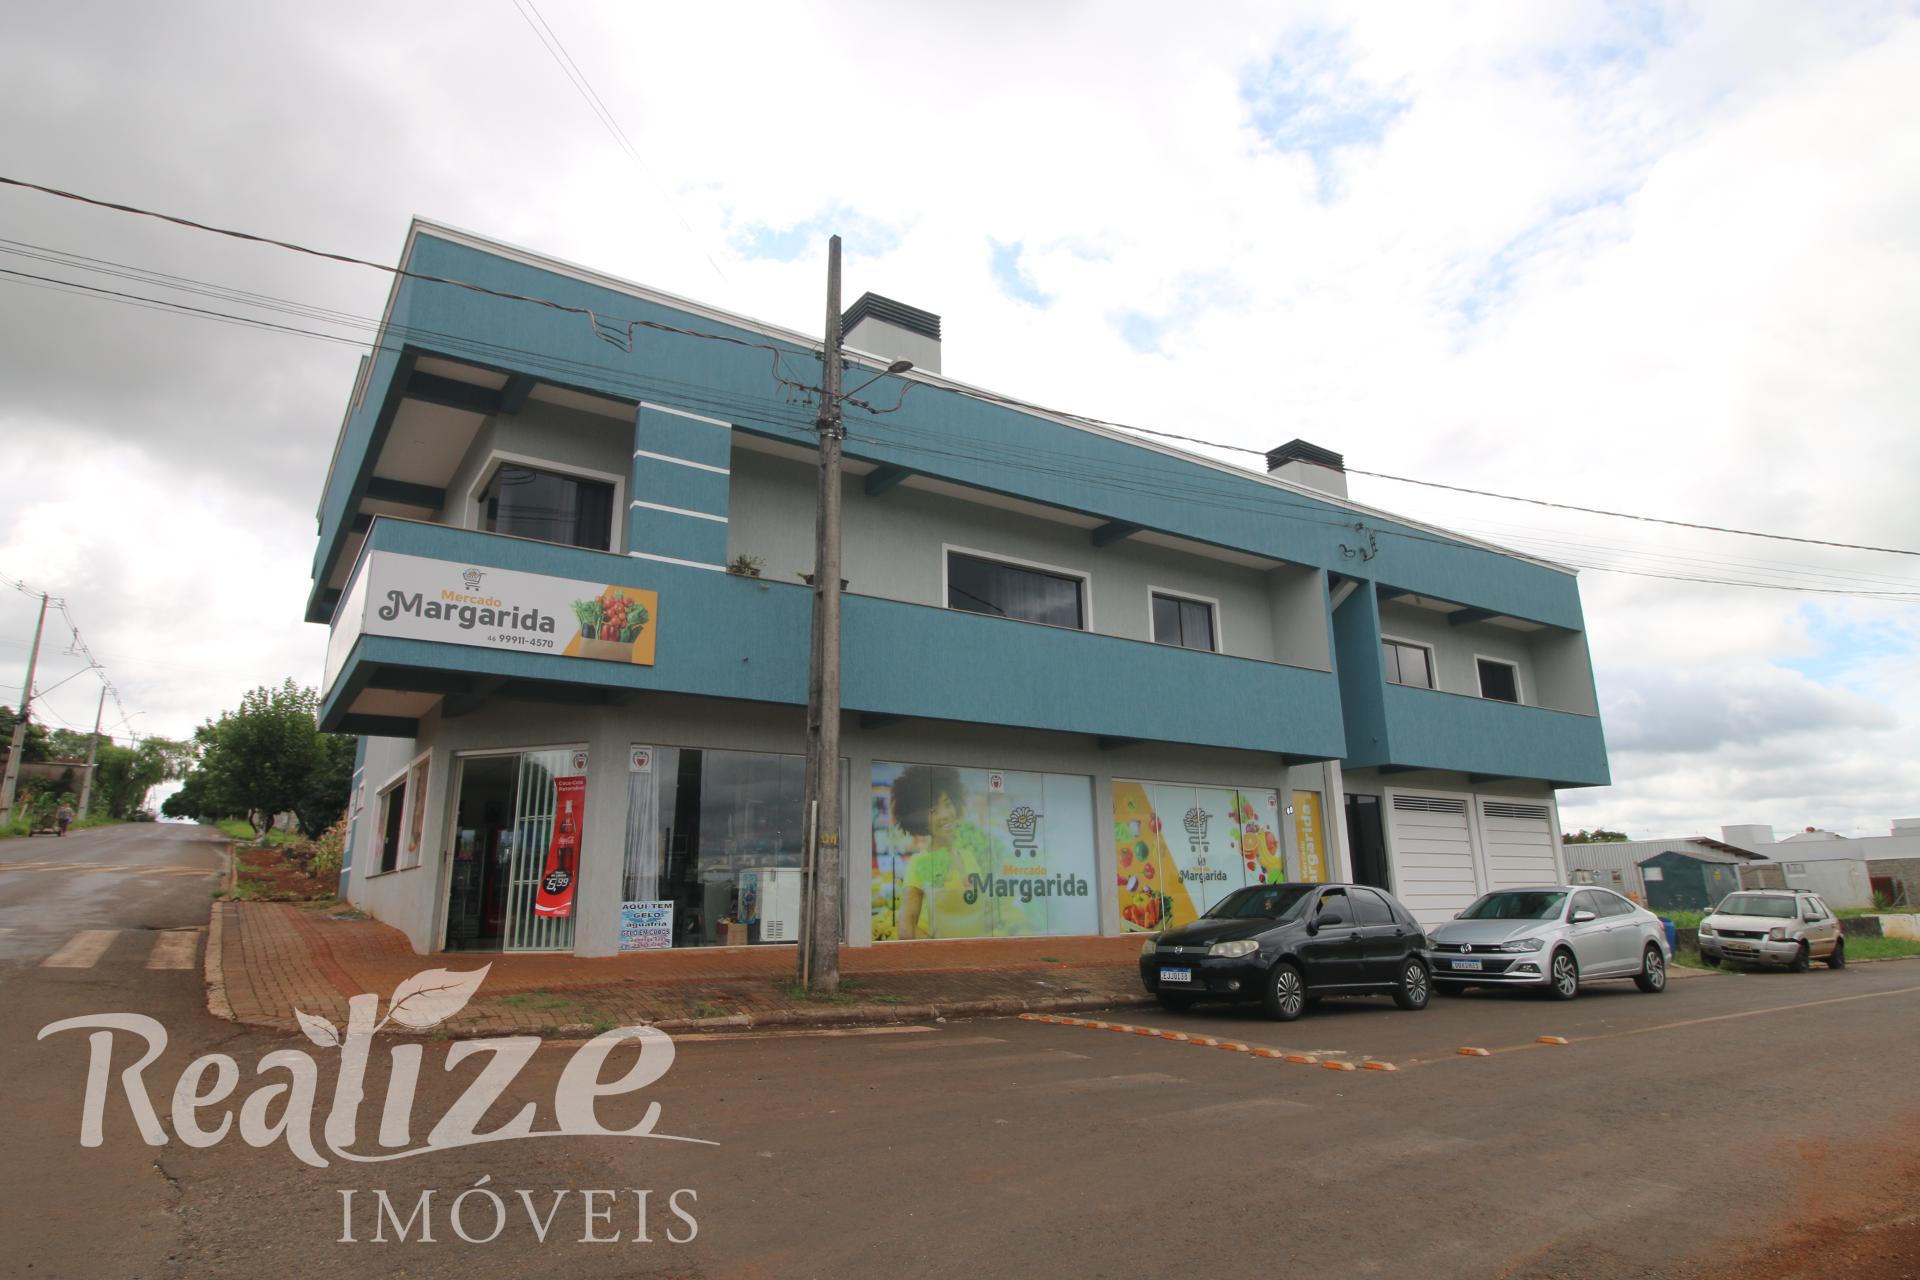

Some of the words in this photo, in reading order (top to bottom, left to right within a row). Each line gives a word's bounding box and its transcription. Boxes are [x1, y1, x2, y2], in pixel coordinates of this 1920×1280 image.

[441, 590, 502, 608] Mercado
[378, 590, 555, 633] Margarida
[499, 634, 554, 648] 99911-4570
[1003, 863, 1047, 877] Mercado
[1178, 870, 1227, 884] Margarida
[963, 872, 1088, 905] Margarida
